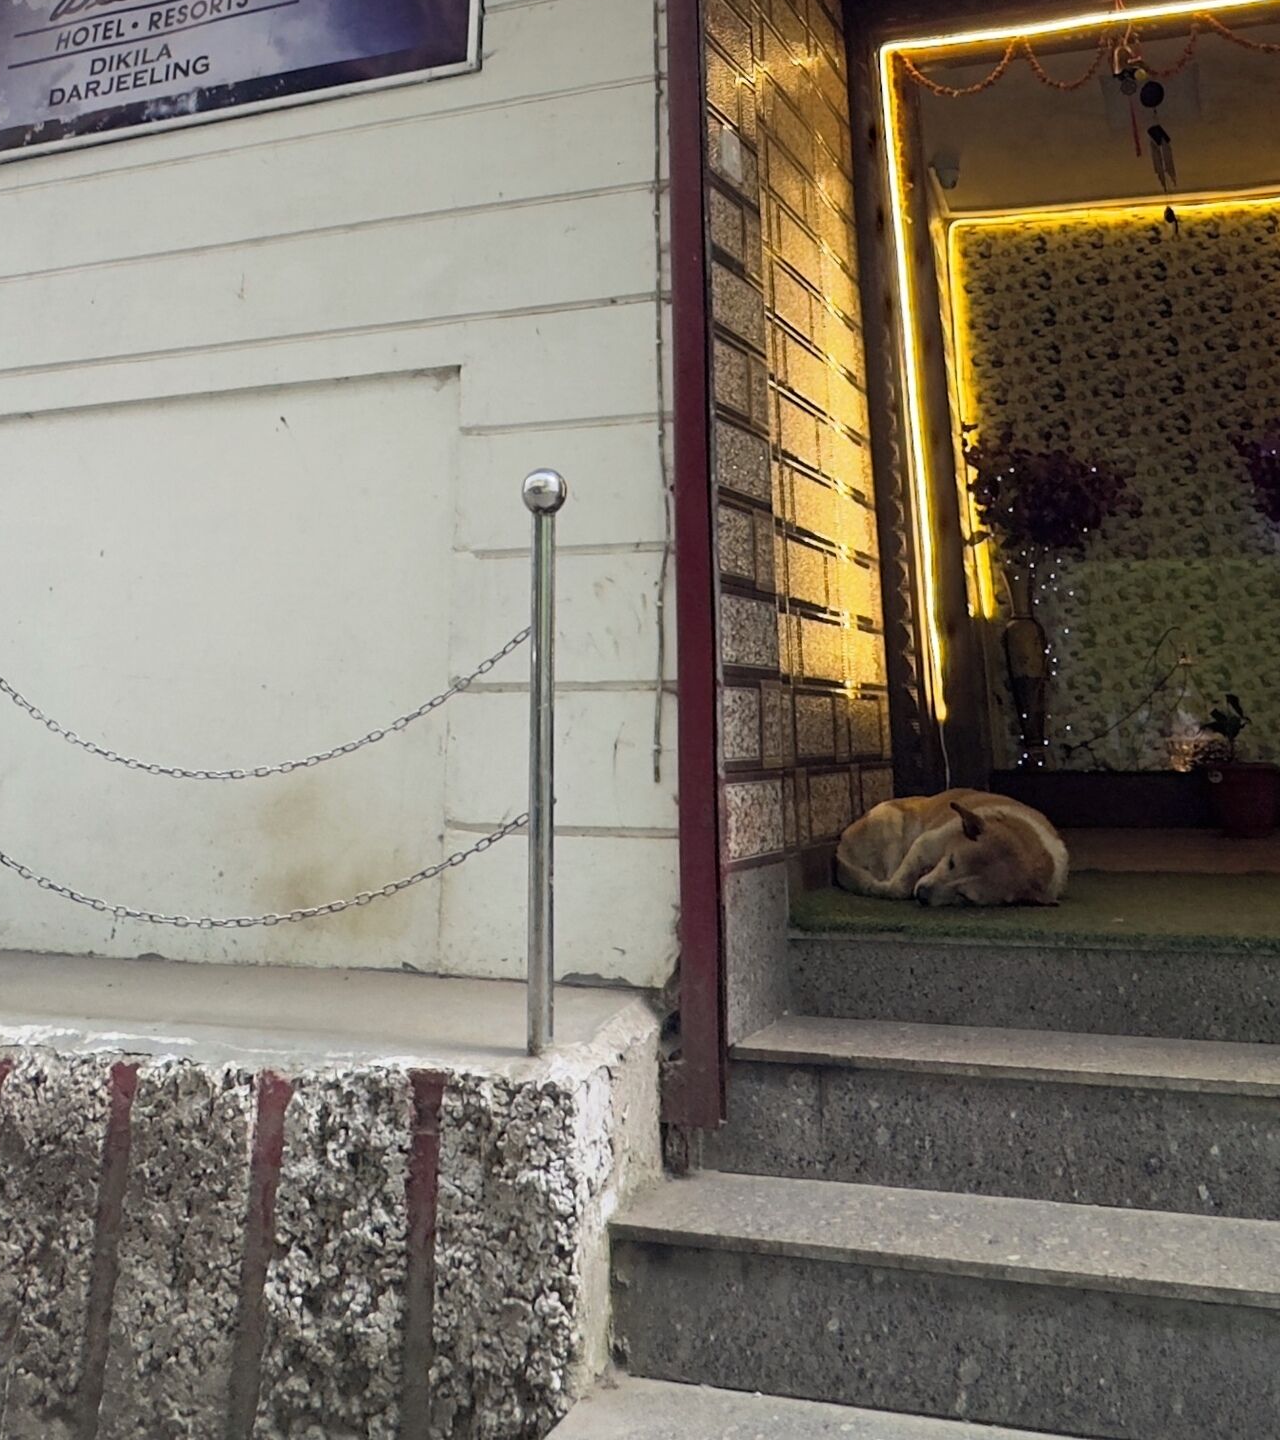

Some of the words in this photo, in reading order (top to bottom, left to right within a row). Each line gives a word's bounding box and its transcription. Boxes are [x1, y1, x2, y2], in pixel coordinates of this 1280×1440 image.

[56, 18, 125, 51] HOTEL
[89, 43, 172, 76] DIKILA
[49, 55, 210, 106] DARJEELING
